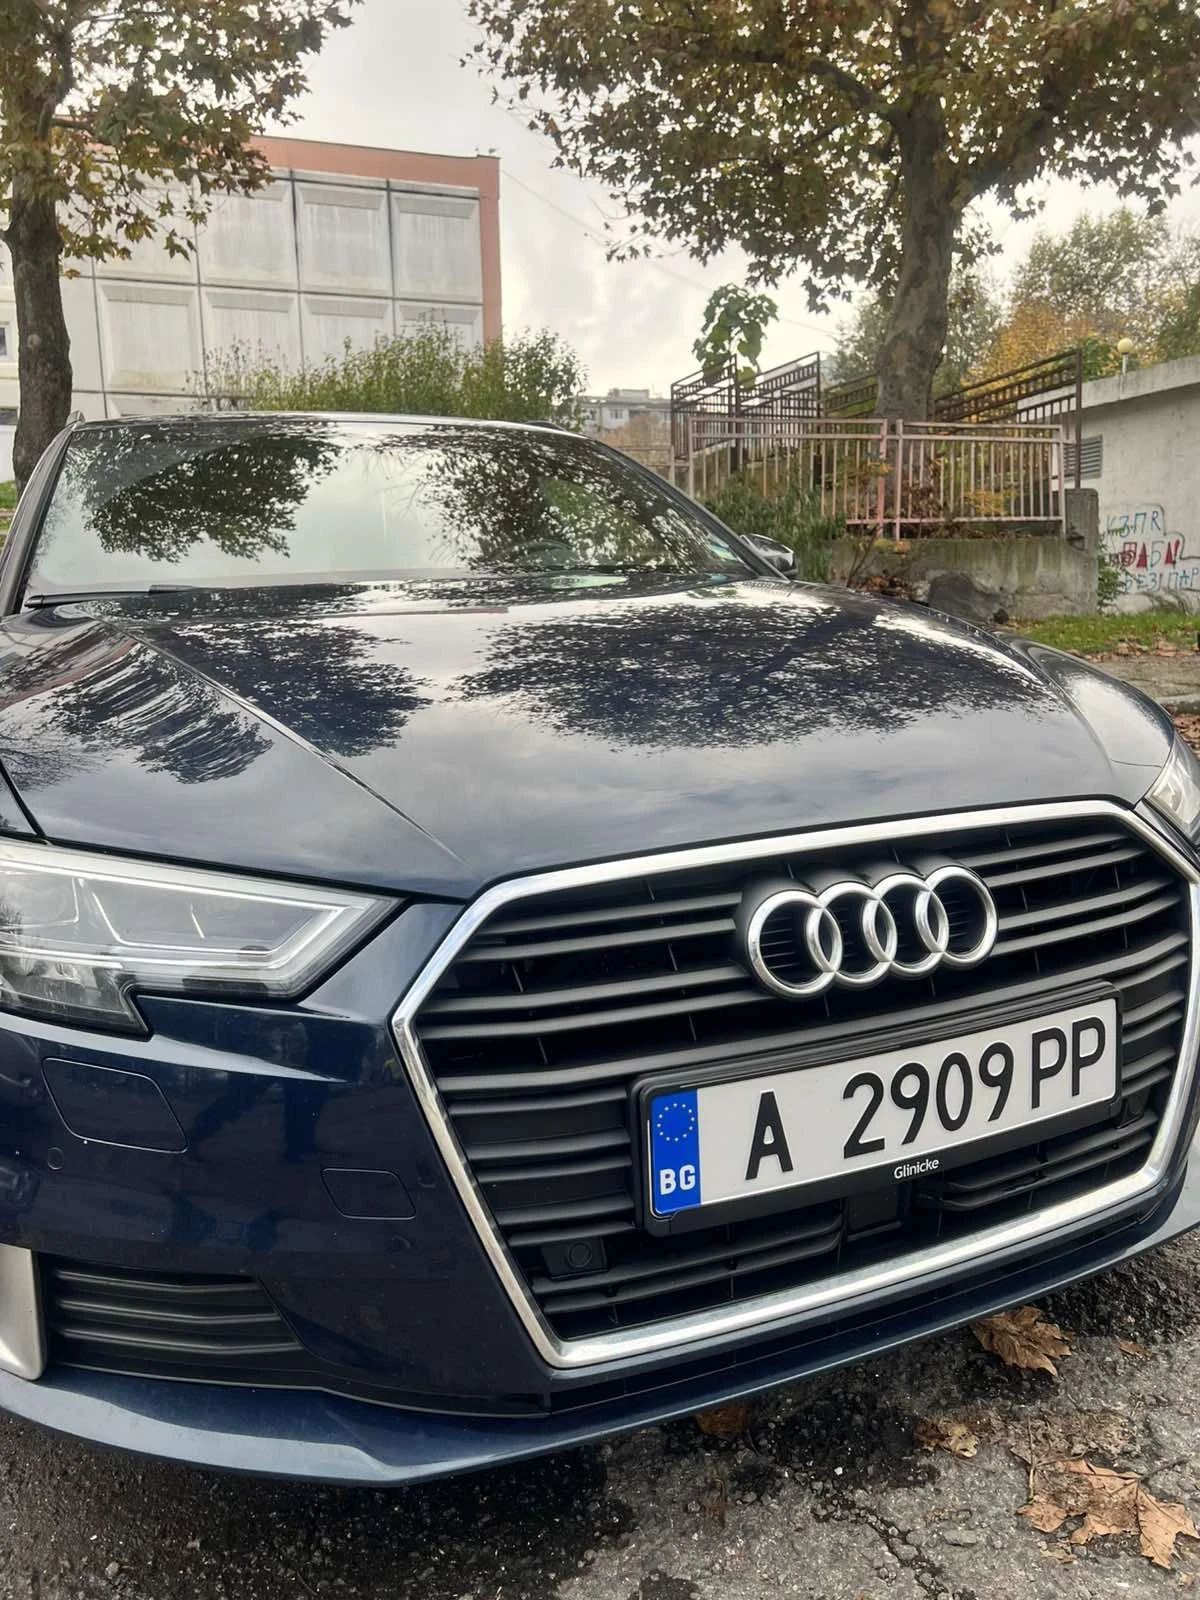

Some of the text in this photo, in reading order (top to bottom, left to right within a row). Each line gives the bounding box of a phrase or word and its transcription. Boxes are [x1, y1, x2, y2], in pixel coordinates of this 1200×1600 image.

[745, 1016, 1106, 1181] A 2909 PP
[660, 1164, 696, 1195] BG
[893, 1158, 940, 1180] Glinicke
